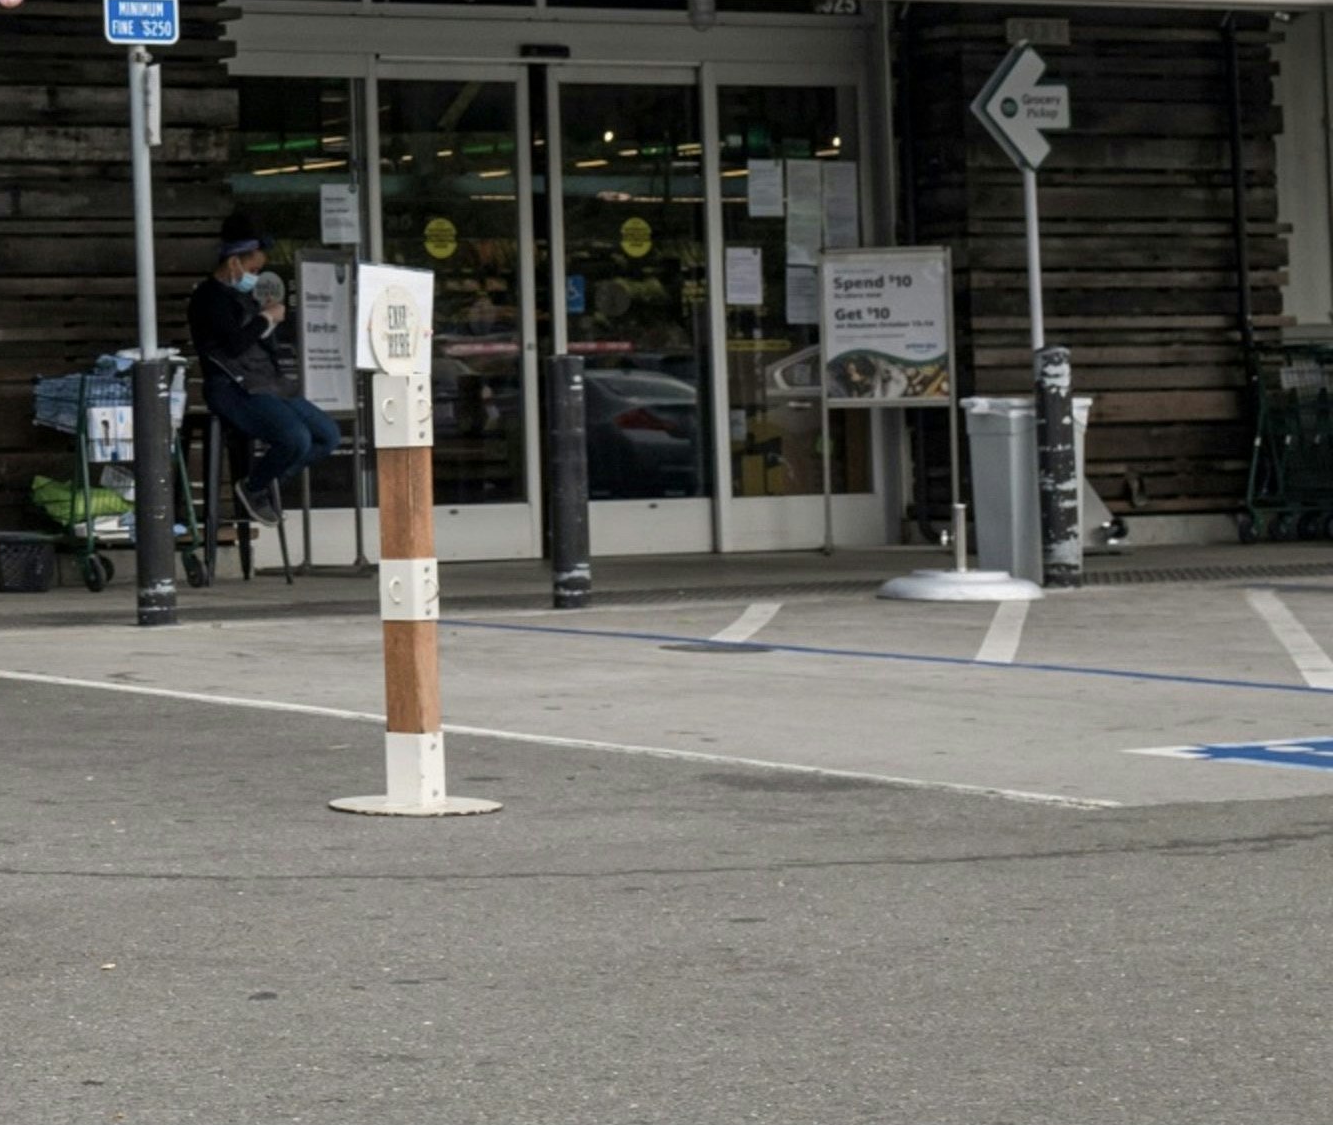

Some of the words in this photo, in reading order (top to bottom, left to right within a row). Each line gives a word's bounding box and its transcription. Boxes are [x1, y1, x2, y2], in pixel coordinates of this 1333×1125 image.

[118, 1, 165, 17] MINIMUM
[112, 19, 135, 35] FINE
[141, 20, 172, 37] $250
[1022, 93, 1061, 105] Grocery
[1027, 107, 1058, 120] Pickup
[833, 275, 884, 292] Spend
[834, 307, 863, 321] Get
